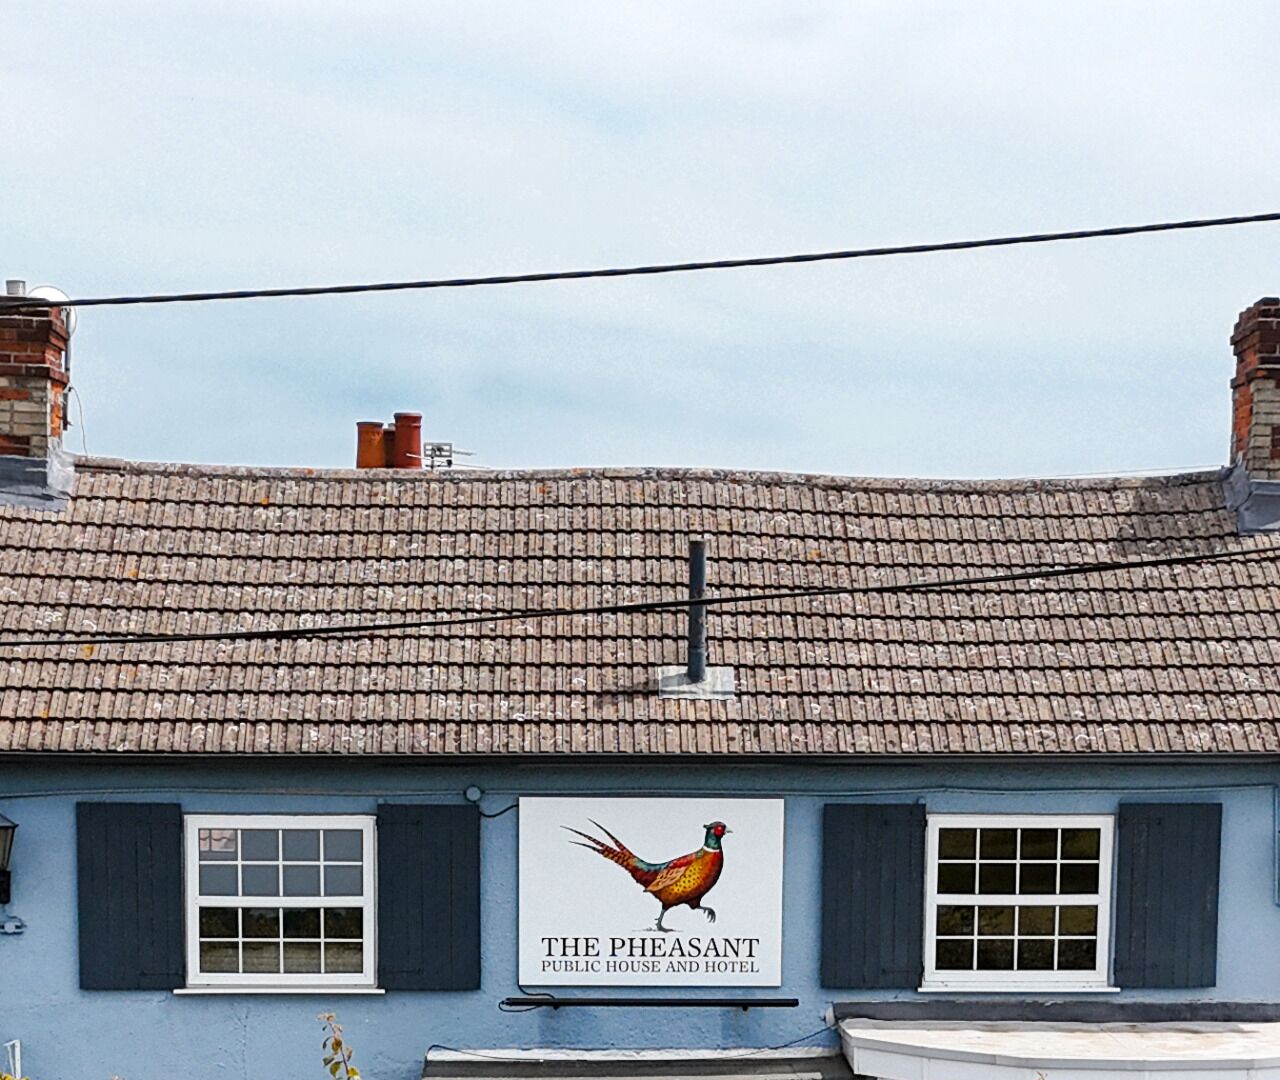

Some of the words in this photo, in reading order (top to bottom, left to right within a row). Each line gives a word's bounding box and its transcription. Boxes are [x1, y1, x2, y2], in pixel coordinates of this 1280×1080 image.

[541, 937, 600, 957] THE
[608, 937, 760, 958] PHEASANT
[541, 960, 601, 973] PUBLIC
[606, 960, 661, 973] HOUSE
[665, 960, 700, 973] AND
[705, 960, 760, 973] HOTEL
